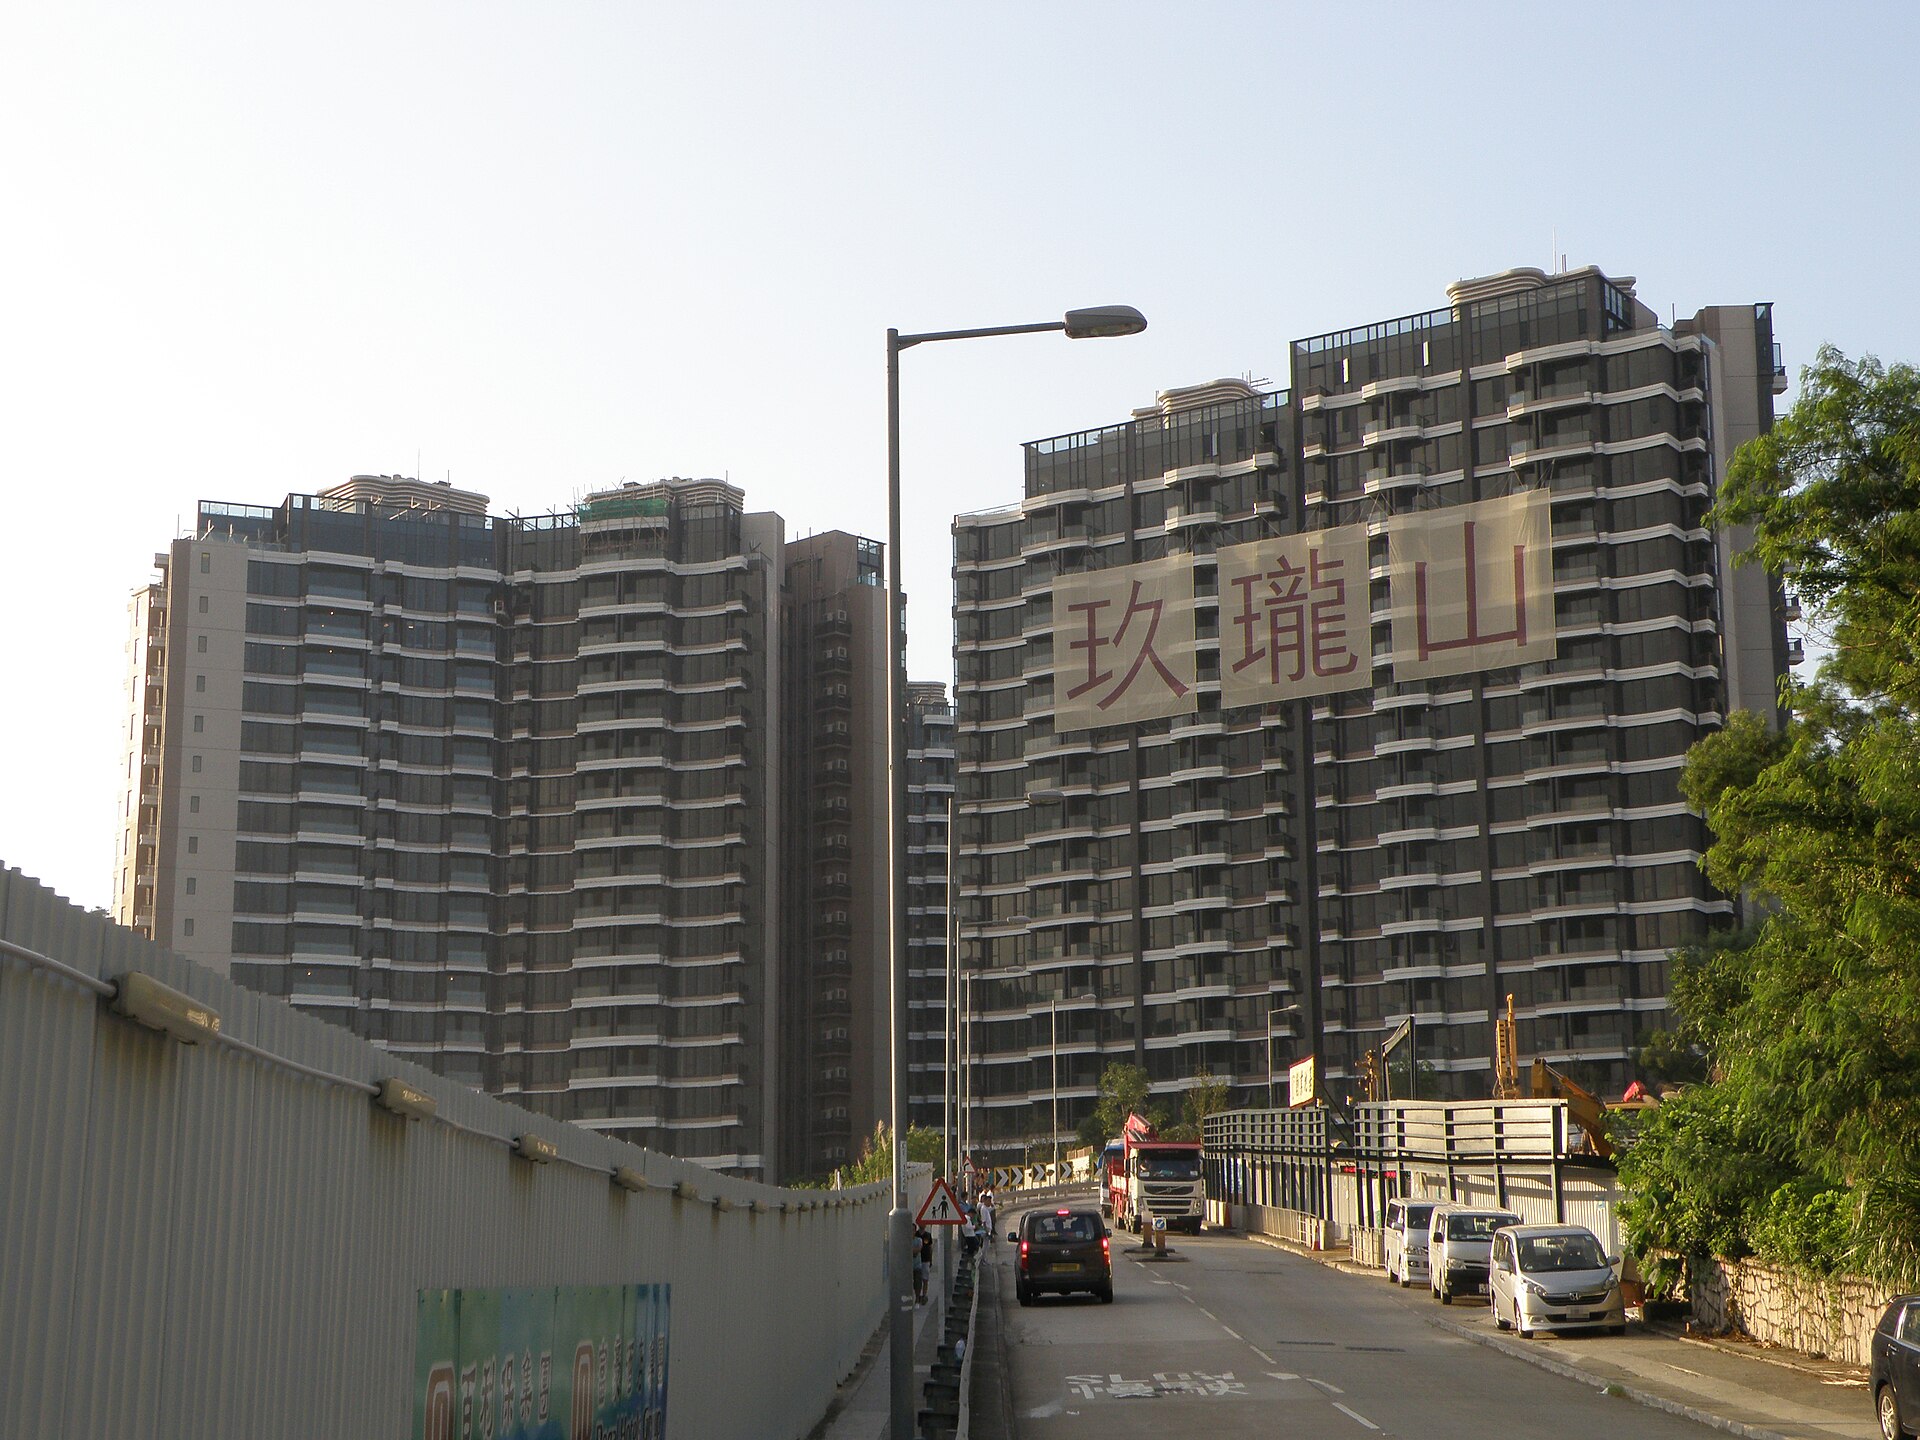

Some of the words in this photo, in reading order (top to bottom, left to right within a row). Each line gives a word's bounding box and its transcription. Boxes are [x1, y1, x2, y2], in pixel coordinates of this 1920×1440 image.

[1067, 521, 1527, 711] 玖瓏山
[461, 1347, 551, 1440] 百利保集團
